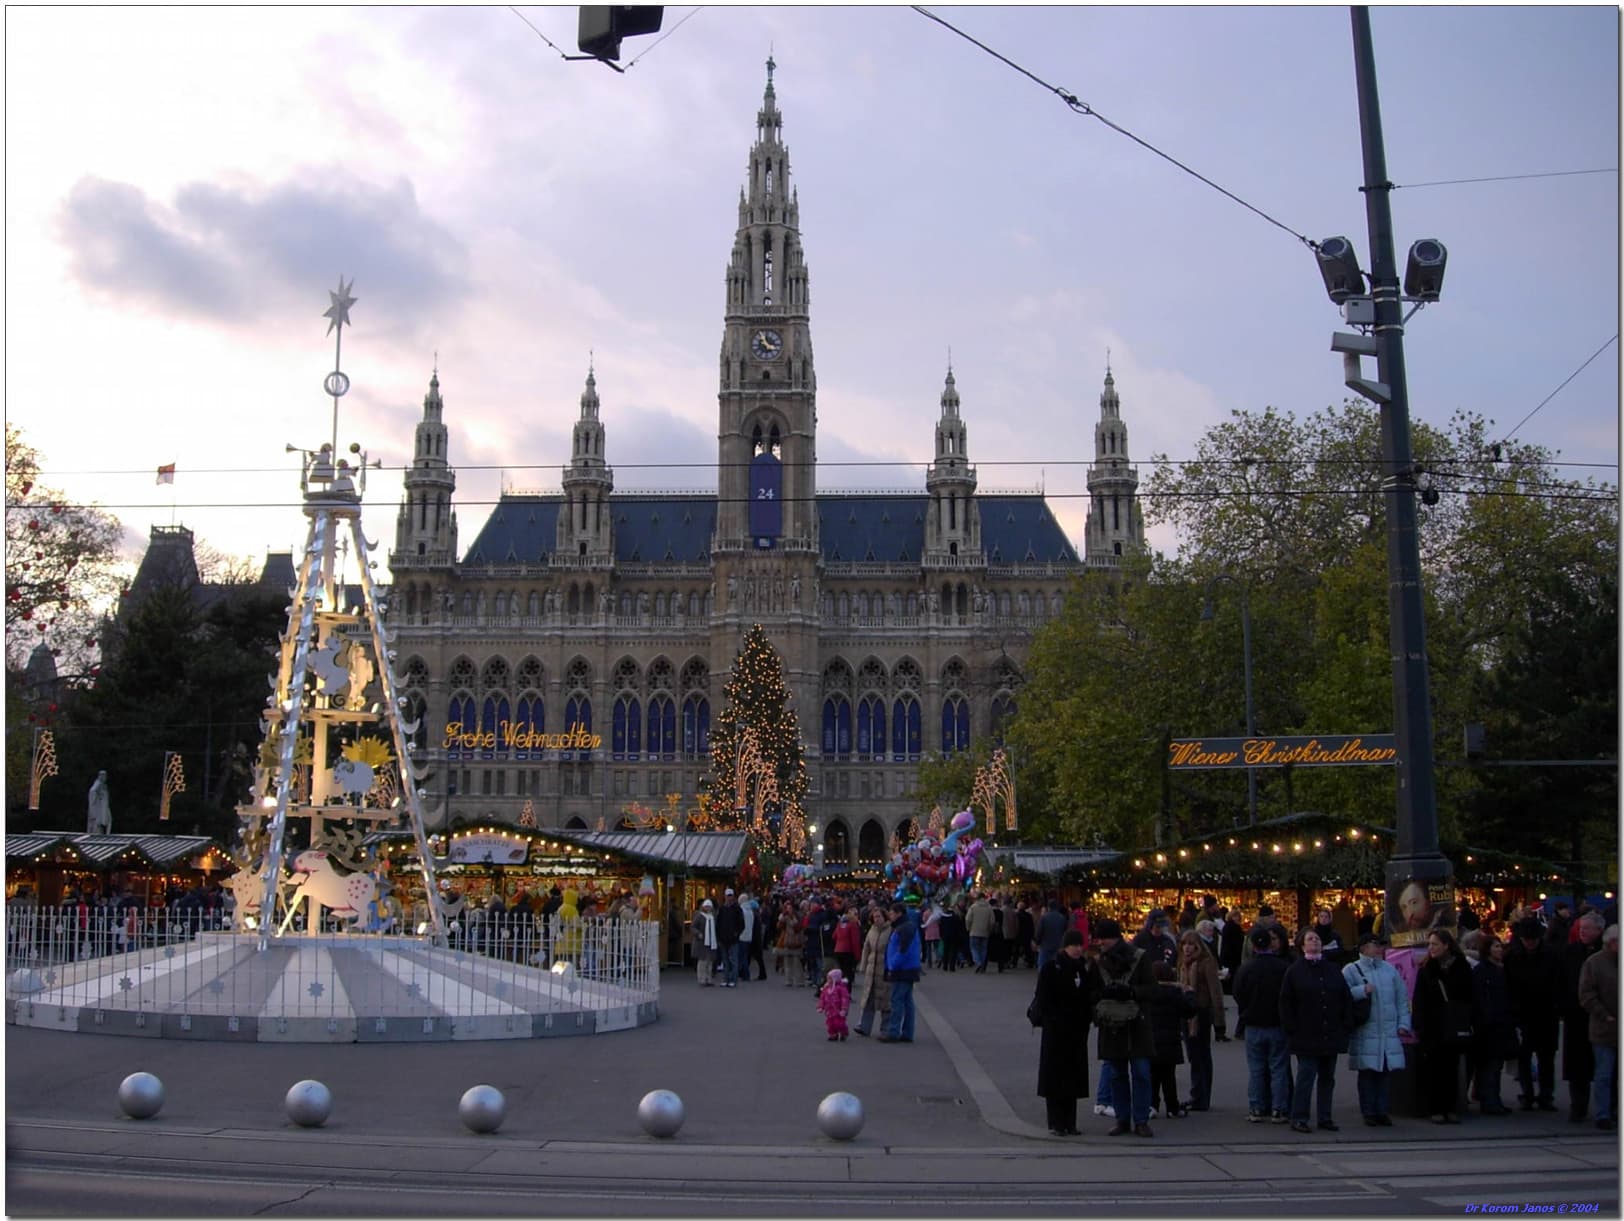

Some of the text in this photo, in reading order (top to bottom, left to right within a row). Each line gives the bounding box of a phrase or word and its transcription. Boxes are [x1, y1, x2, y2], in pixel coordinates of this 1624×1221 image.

[757, 488, 774, 499] 24
[442, 720, 602, 749] Frohe Weihnachten
[1169, 738, 1397, 766] Wiener Christkindlmar
